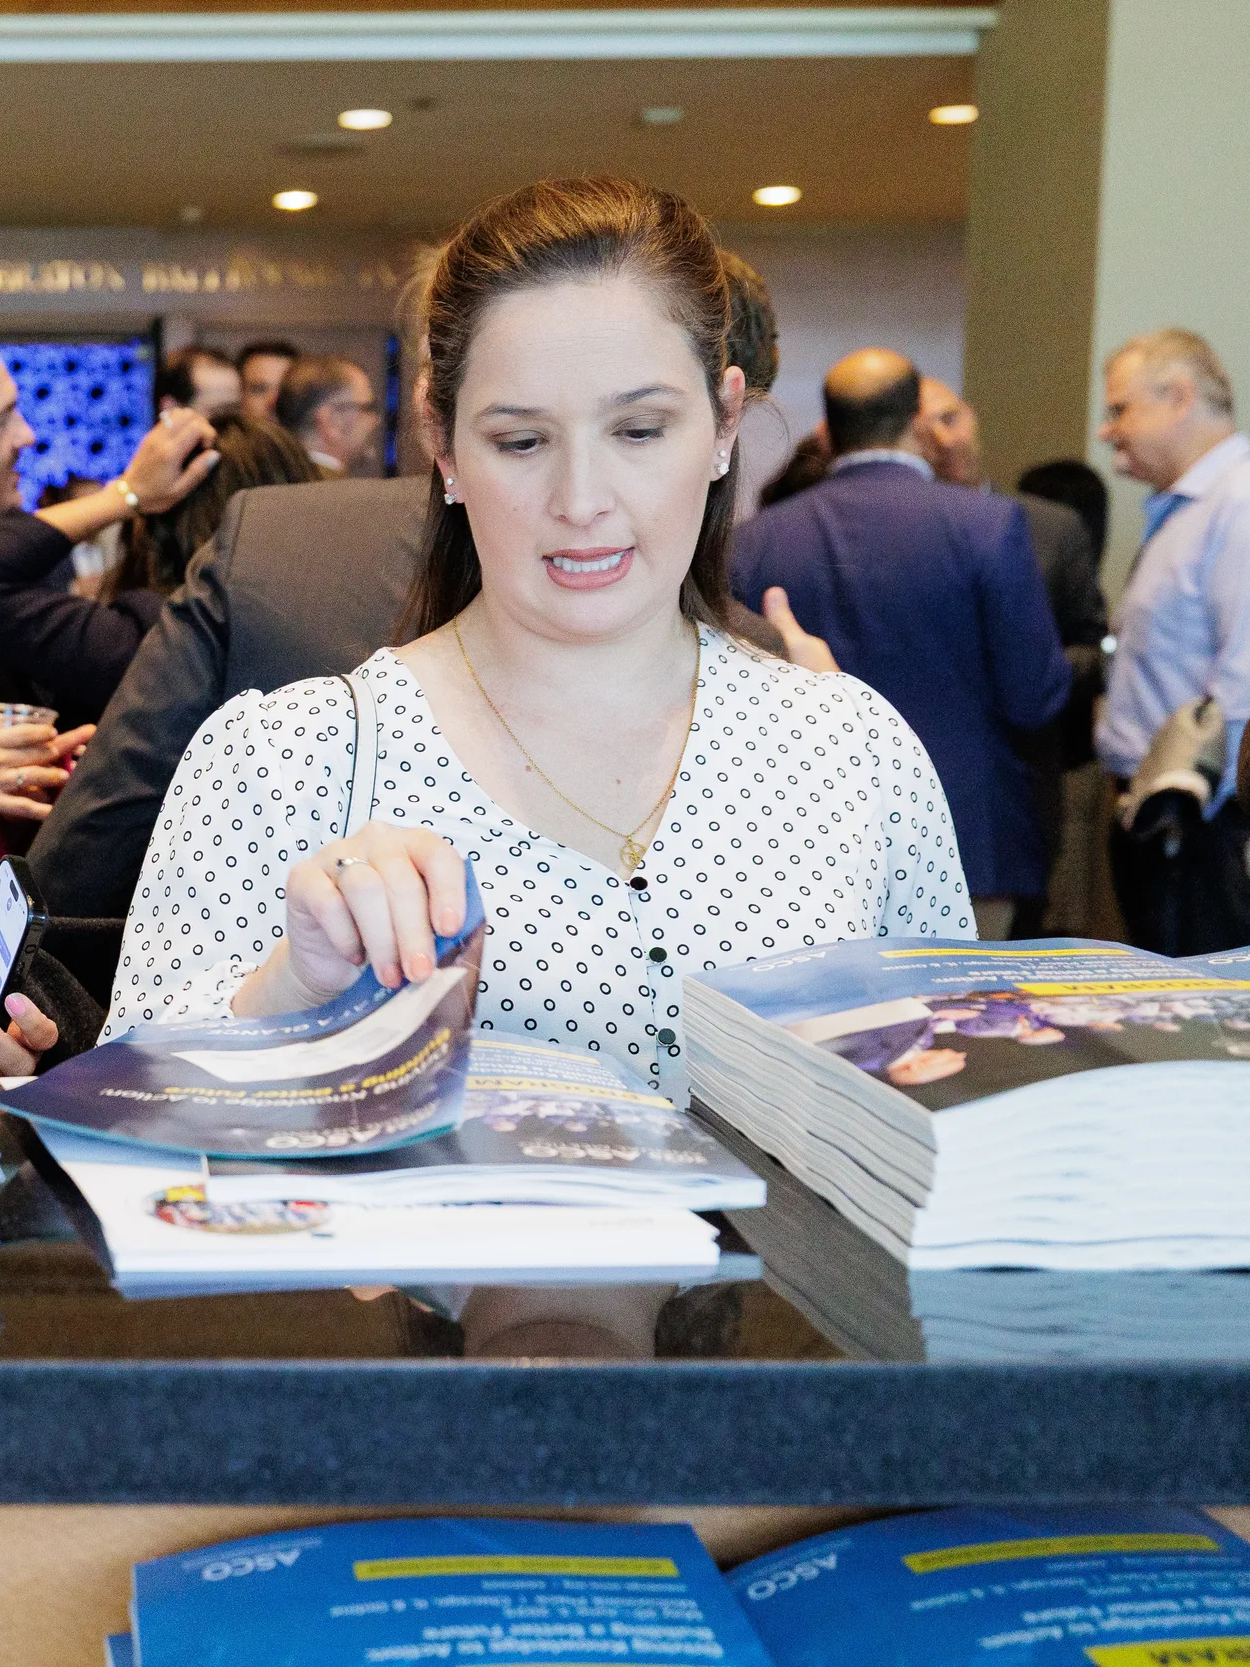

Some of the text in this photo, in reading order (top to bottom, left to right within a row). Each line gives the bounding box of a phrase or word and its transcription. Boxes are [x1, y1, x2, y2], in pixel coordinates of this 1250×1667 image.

[752, 951, 827, 972] ASCO
[207, 1023, 310, 1036] GLANCE
[164, 1086, 247, 1099] Future
[252, 1086, 334, 1099] Better
[338, 1082, 357, 1093] a
[192, 1096, 218, 1106] to
[224, 1089, 368, 1108] Knowledge
[265, 1125, 385, 1149] ASCO
[201, 1548, 302, 1582] ASCO
[746, 1552, 838, 1601] ASCO
